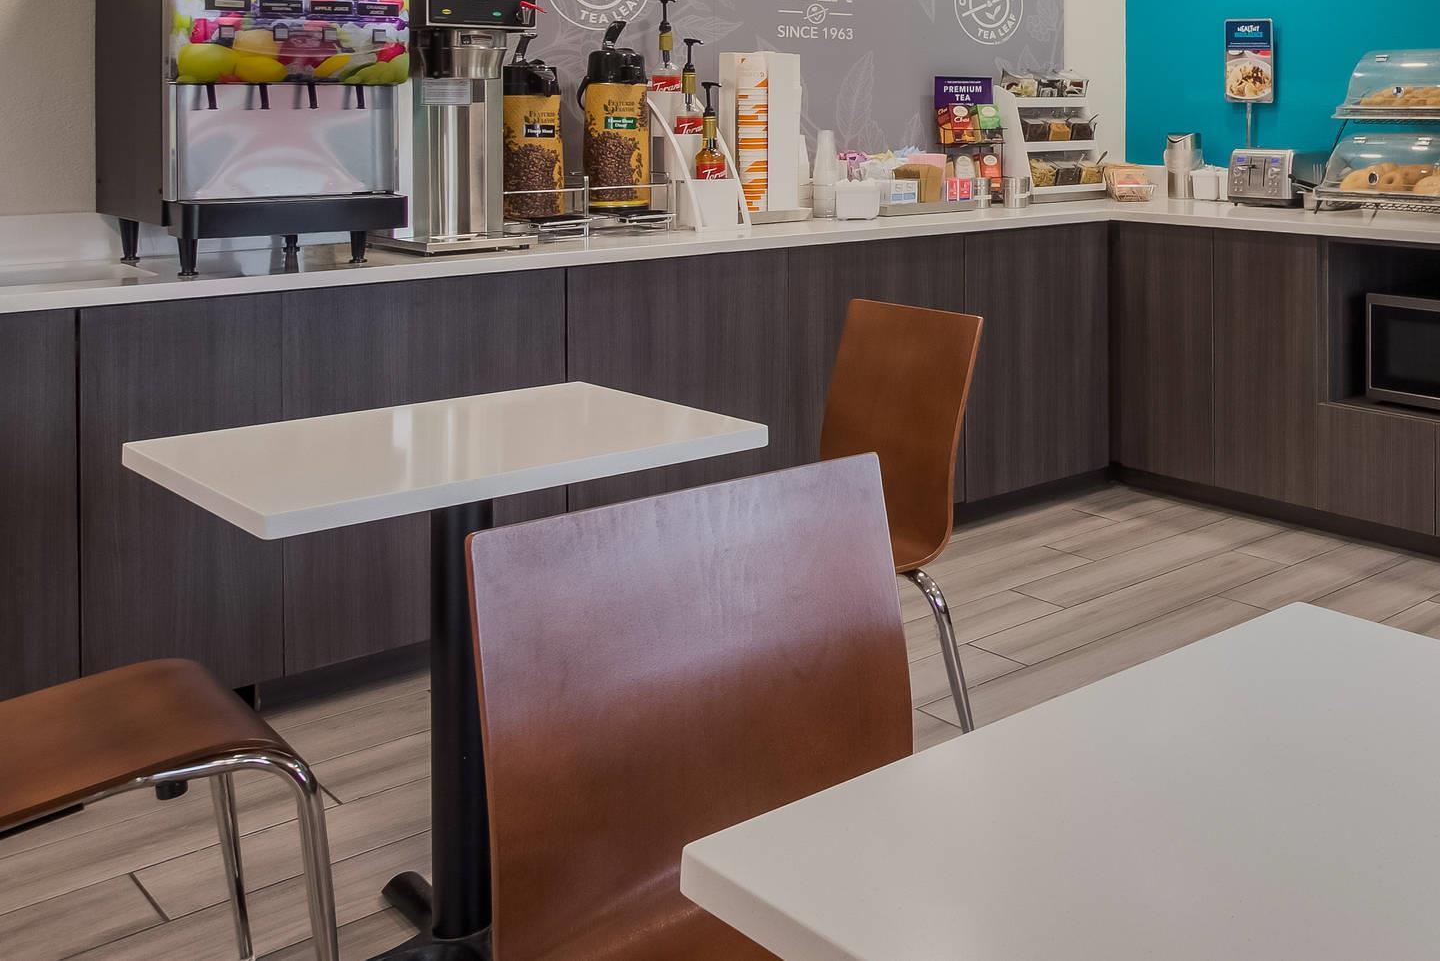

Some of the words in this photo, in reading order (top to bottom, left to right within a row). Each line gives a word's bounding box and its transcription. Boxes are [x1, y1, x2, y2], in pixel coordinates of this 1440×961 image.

[581, 9, 609, 24] TEA
[777, 25, 819, 39] SINCE
[822, 27, 853, 40] 1963
[977, 27, 997, 40] TEA
[998, 13, 1017, 36] LEAF
[943, 85, 983, 93] PREMIUM
